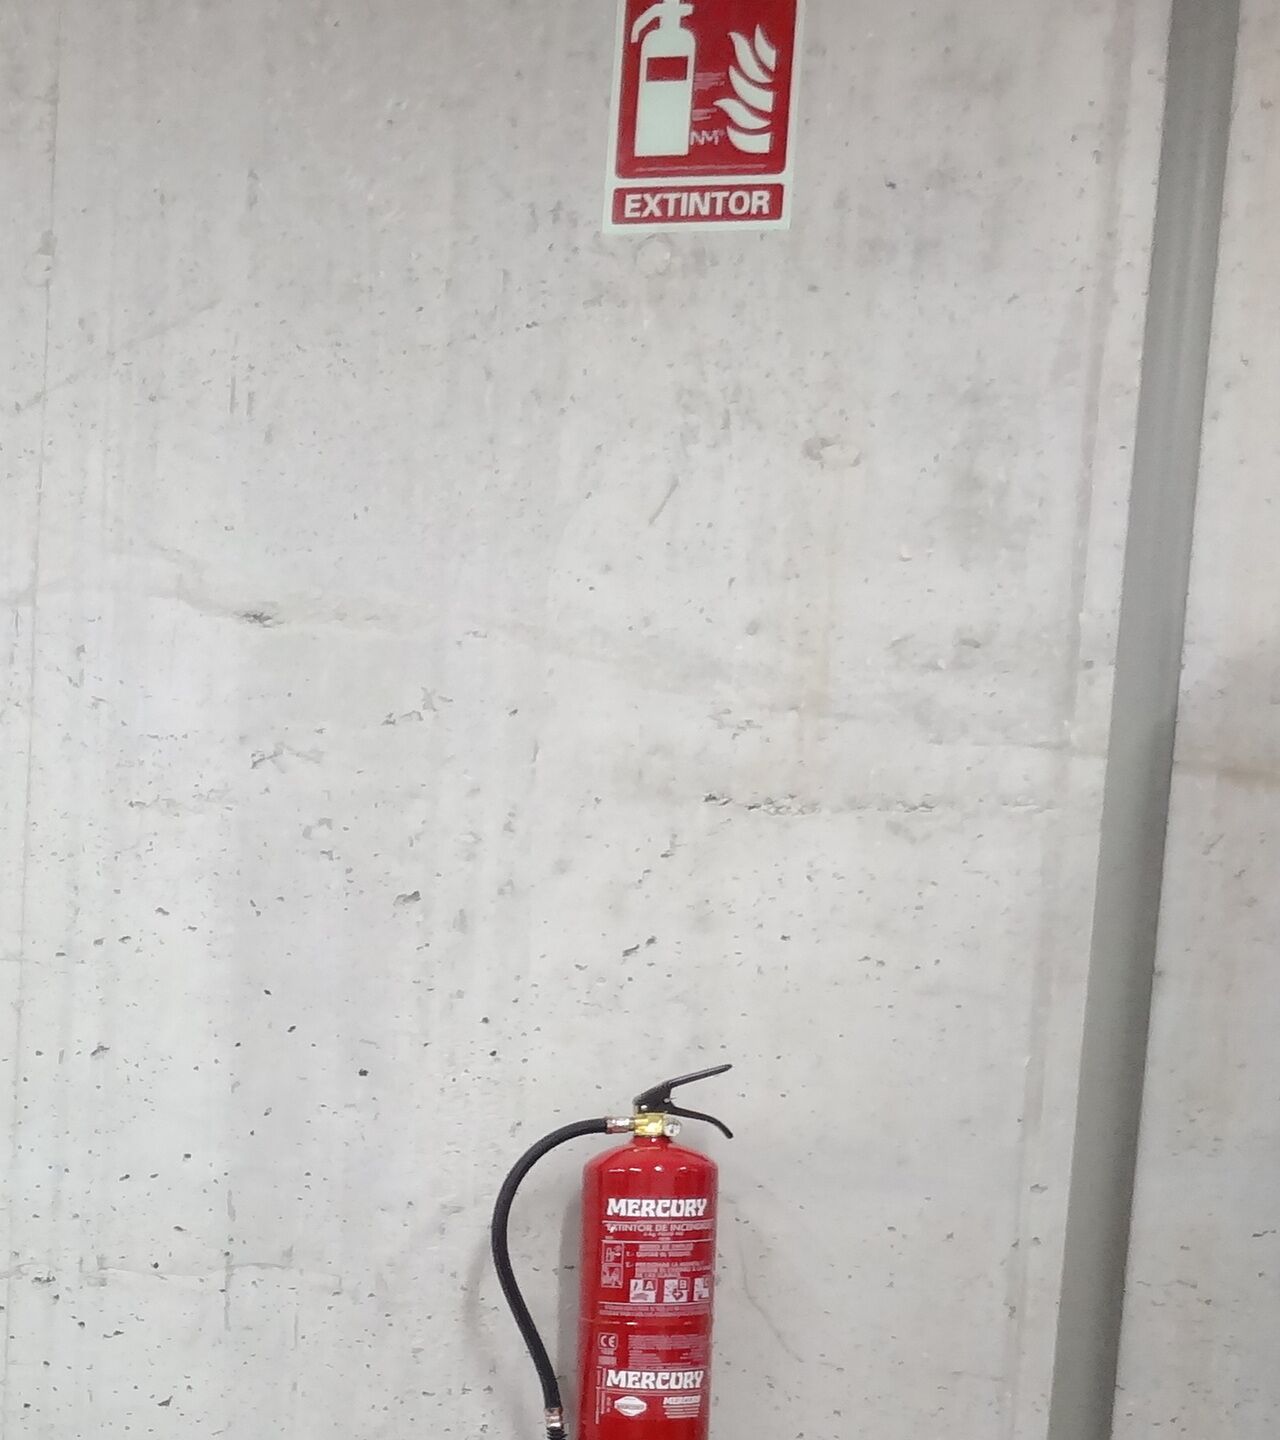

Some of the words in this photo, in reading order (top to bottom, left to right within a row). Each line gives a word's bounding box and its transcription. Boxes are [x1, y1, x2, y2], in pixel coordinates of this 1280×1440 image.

[623, 190, 771, 219] EXTINTOR
[606, 1198, 708, 1218] MERCURY
[606, 1369, 704, 1390] MERCURY
